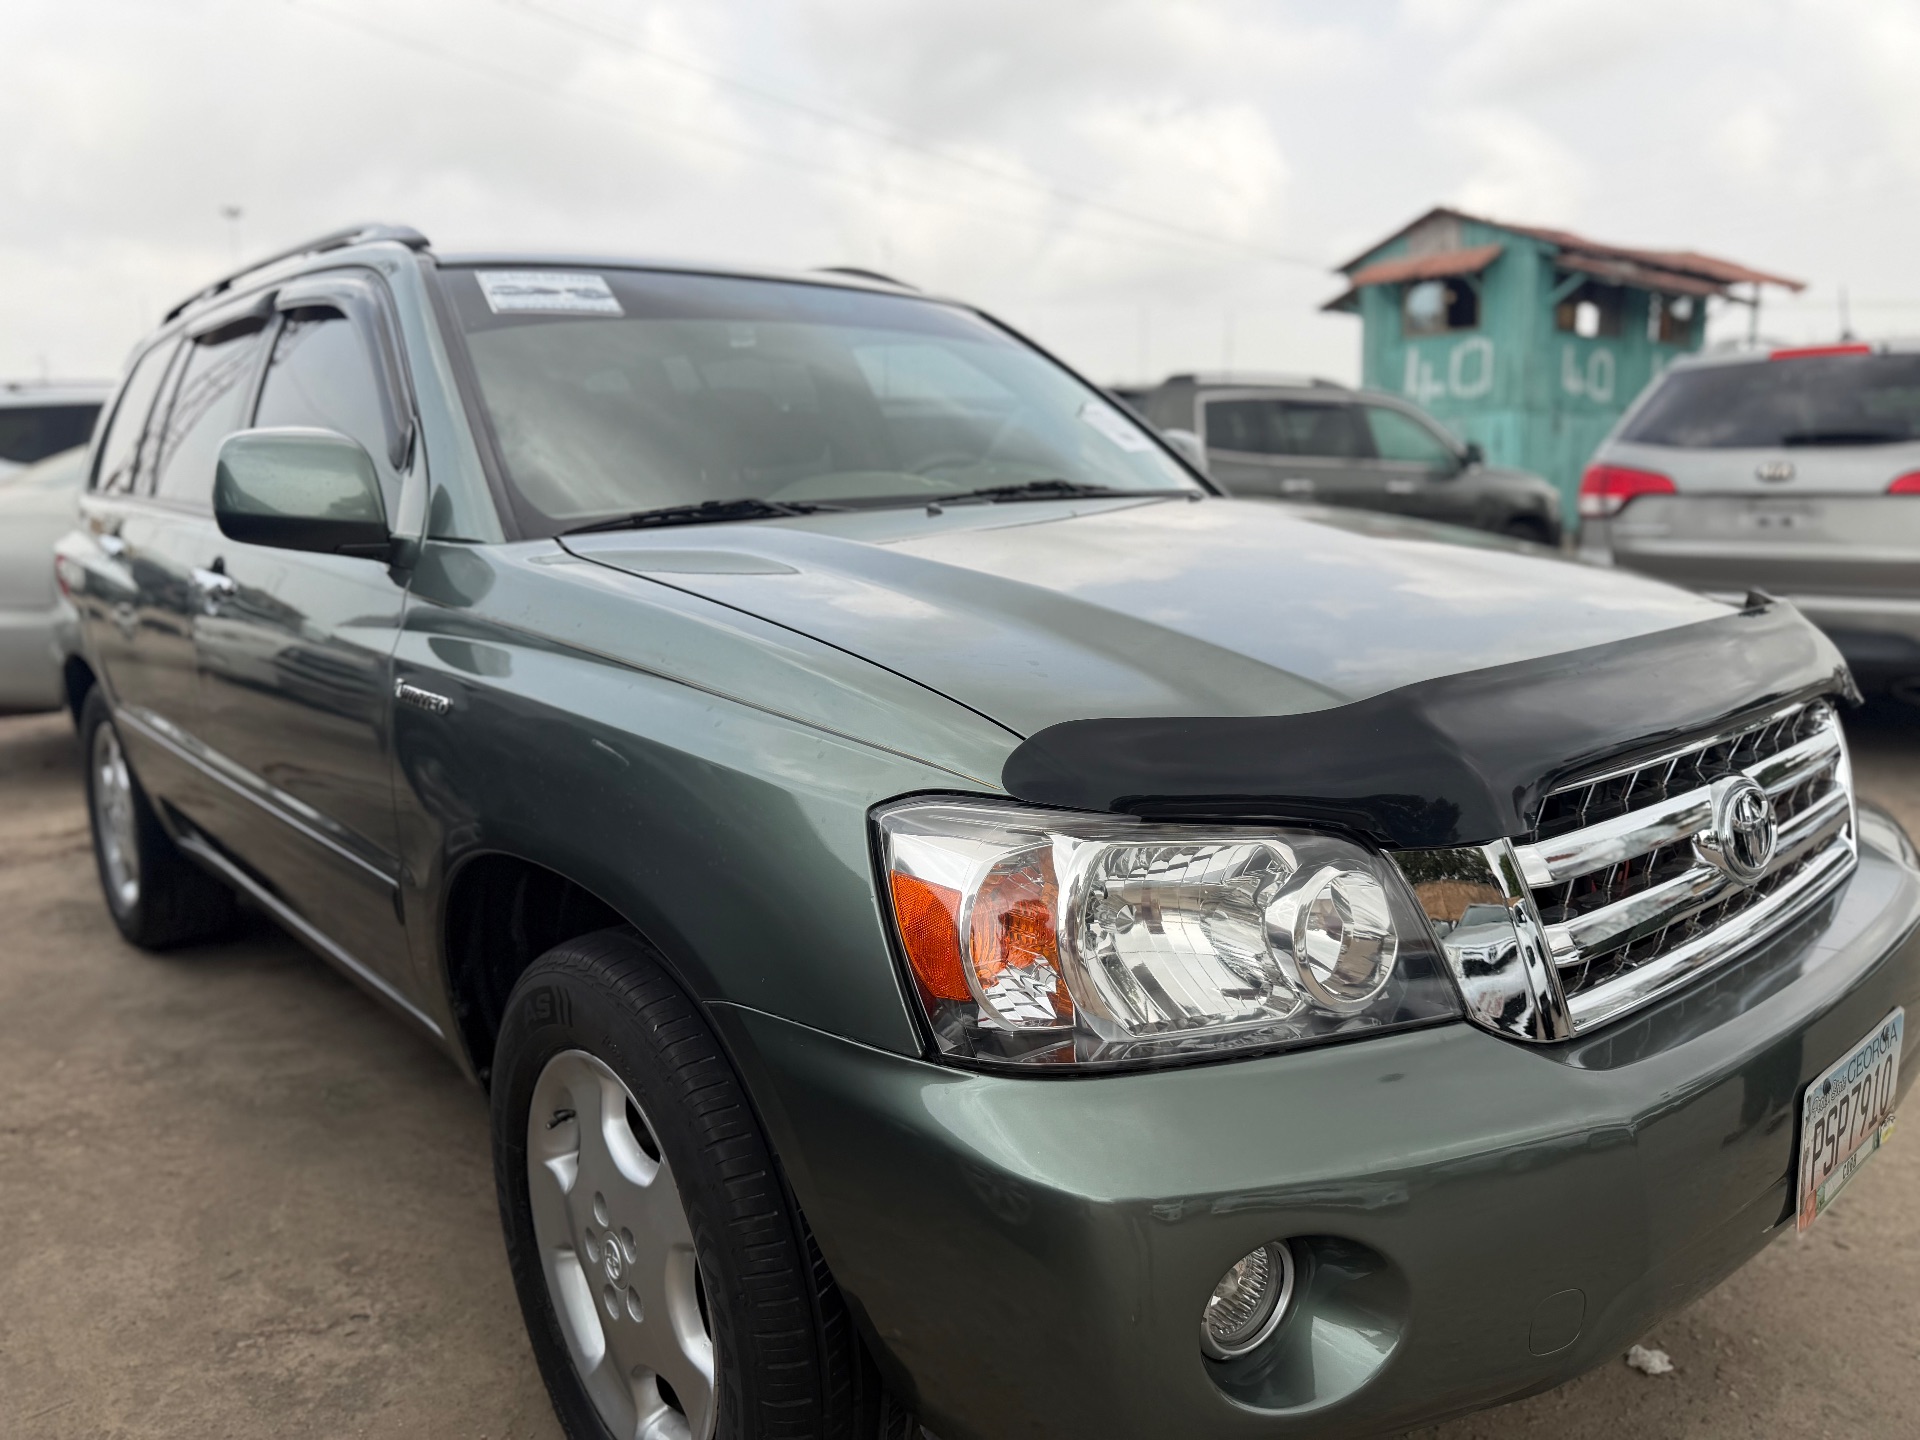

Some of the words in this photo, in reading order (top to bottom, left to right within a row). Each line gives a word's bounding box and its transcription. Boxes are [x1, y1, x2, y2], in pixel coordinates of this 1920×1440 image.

[1405, 336, 1495, 402] 40
[1847, 1022, 1898, 1085] GEORGIA
[1810, 1053, 1893, 1192] PSP7910
